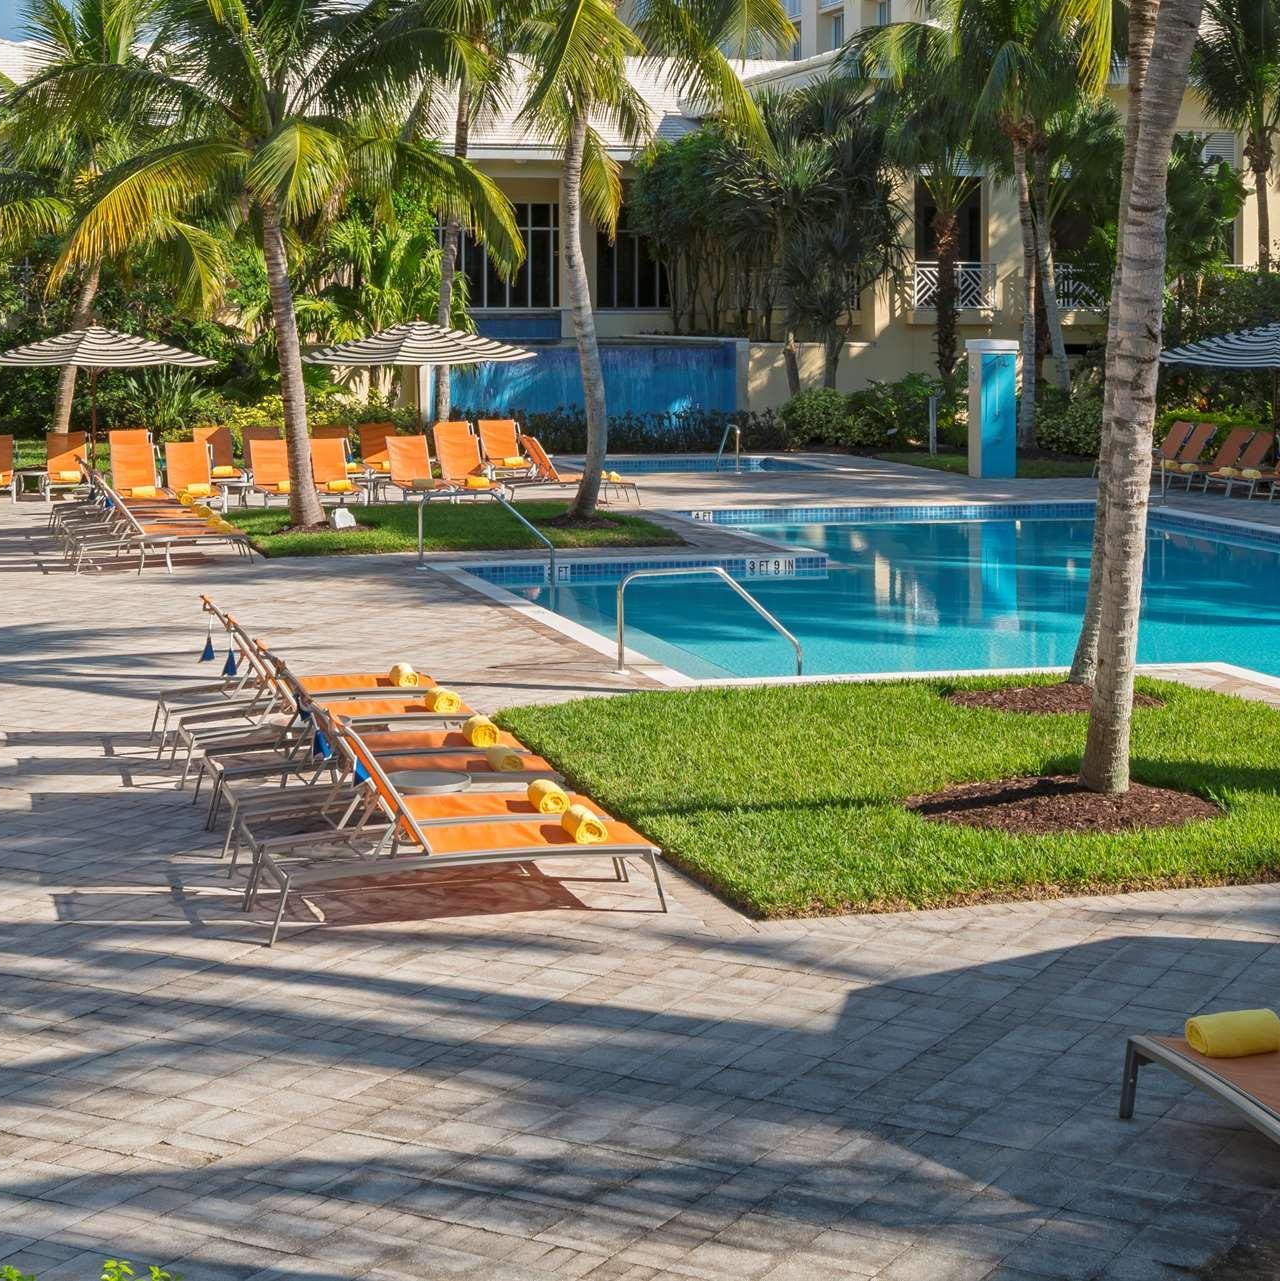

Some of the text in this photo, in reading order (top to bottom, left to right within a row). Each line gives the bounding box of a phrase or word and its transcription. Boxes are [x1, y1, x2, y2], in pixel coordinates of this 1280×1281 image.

[703, 511, 711, 521] FT
[749, 560, 794, 571] 3 FT 9 IN
[558, 566, 568, 576] FT
